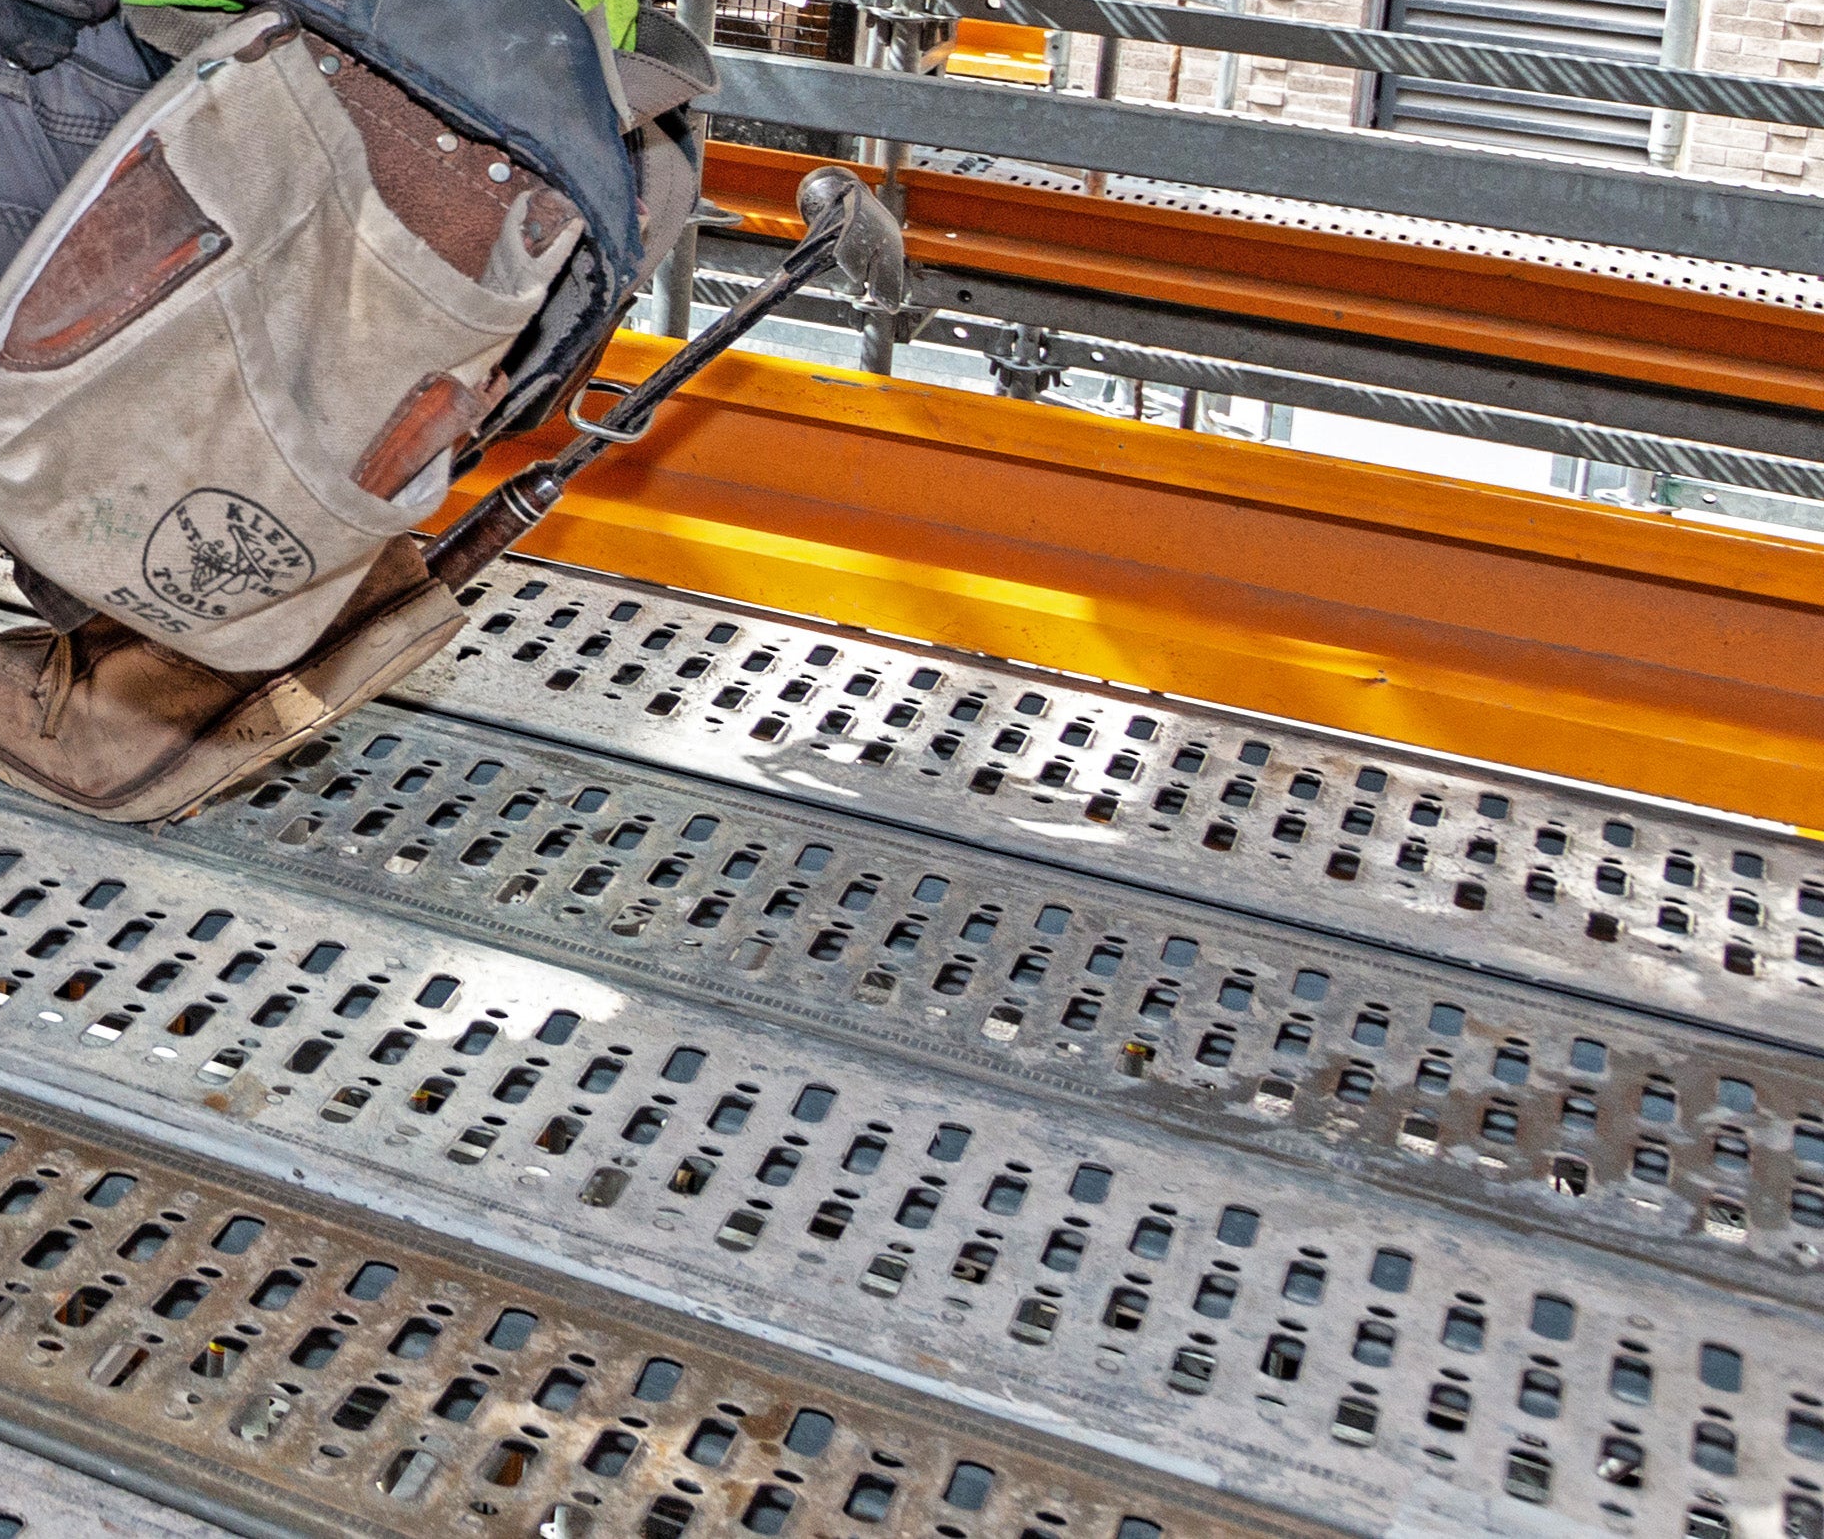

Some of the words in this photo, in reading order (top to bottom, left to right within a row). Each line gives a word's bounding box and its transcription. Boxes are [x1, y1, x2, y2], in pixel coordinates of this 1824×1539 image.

[225, 502, 305, 569] KLEIN
[104, 586, 193, 634] 5125
[153, 566, 228, 616] TOOLS
